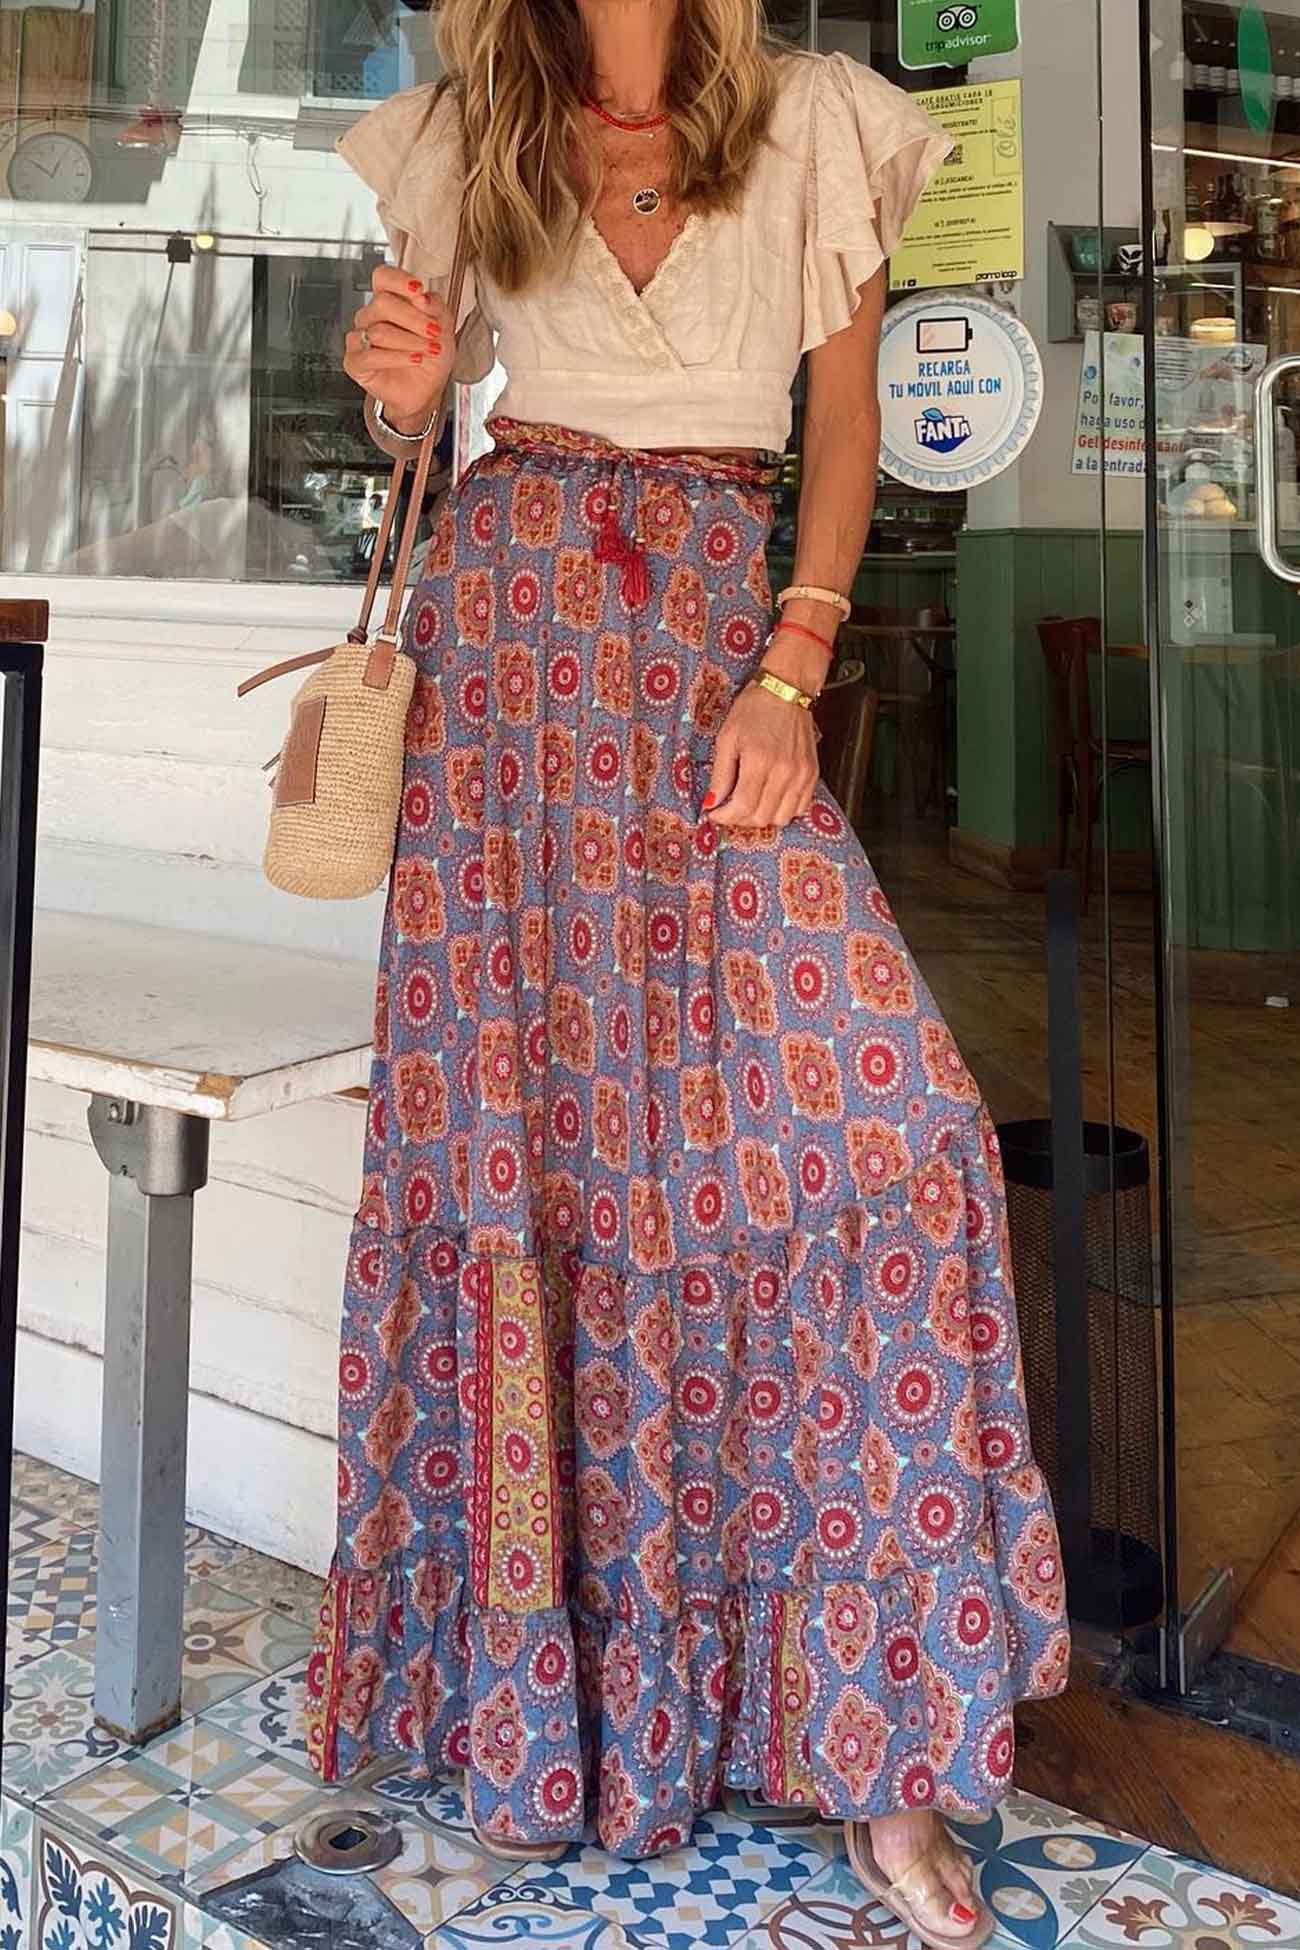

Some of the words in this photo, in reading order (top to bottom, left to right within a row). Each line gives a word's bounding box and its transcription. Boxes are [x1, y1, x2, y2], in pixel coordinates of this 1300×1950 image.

[925, 34, 991, 52] tripadvisor
[918, 360, 971, 378] RECARGA
[888, 383, 904, 400] TU
[978, 377, 1002, 394] CON
[1083, 390, 1103, 405] Po
[915, 416, 971, 443] FANTA
[1114, 417, 1136, 429] uso
[1078, 434, 1098, 449] Gel
[1074, 459, 1083, 469] a
[1086, 456, 1098, 471] la
[1103, 459, 1147, 473] entrad
